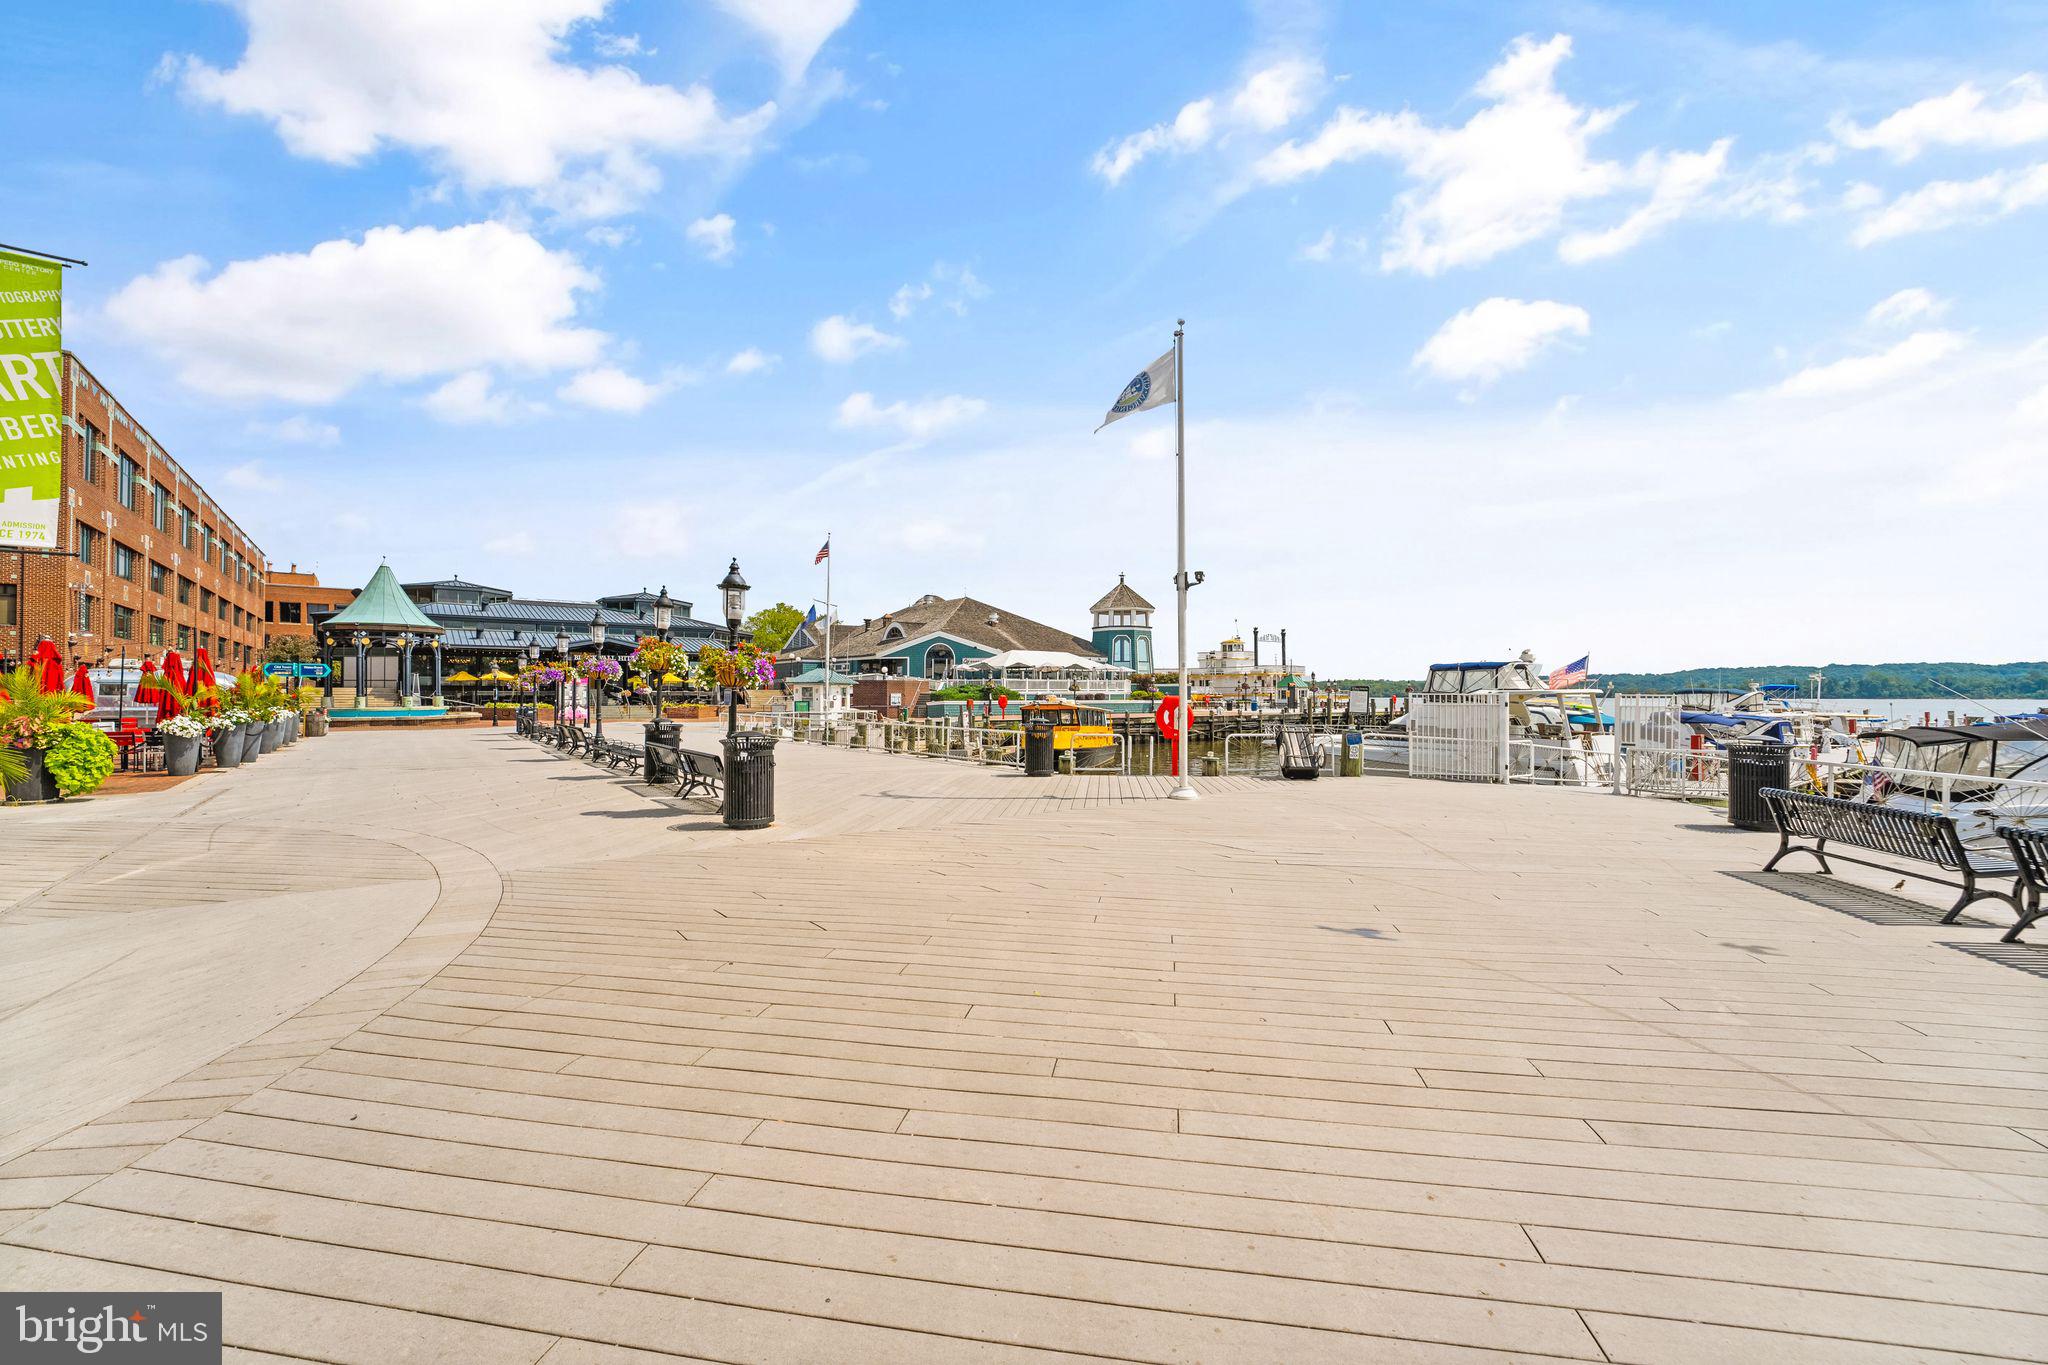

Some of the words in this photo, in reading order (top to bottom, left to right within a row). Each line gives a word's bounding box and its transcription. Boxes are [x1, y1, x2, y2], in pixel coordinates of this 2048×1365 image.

[21, 263, 54, 275] FACTORY
[0, 316, 62, 339] TTERY
[0, 413, 62, 441] BER
[0, 450, 61, 470] NTING
[1, 520, 46, 530] ADMISSION
[18, 530, 45, 541] 1974
